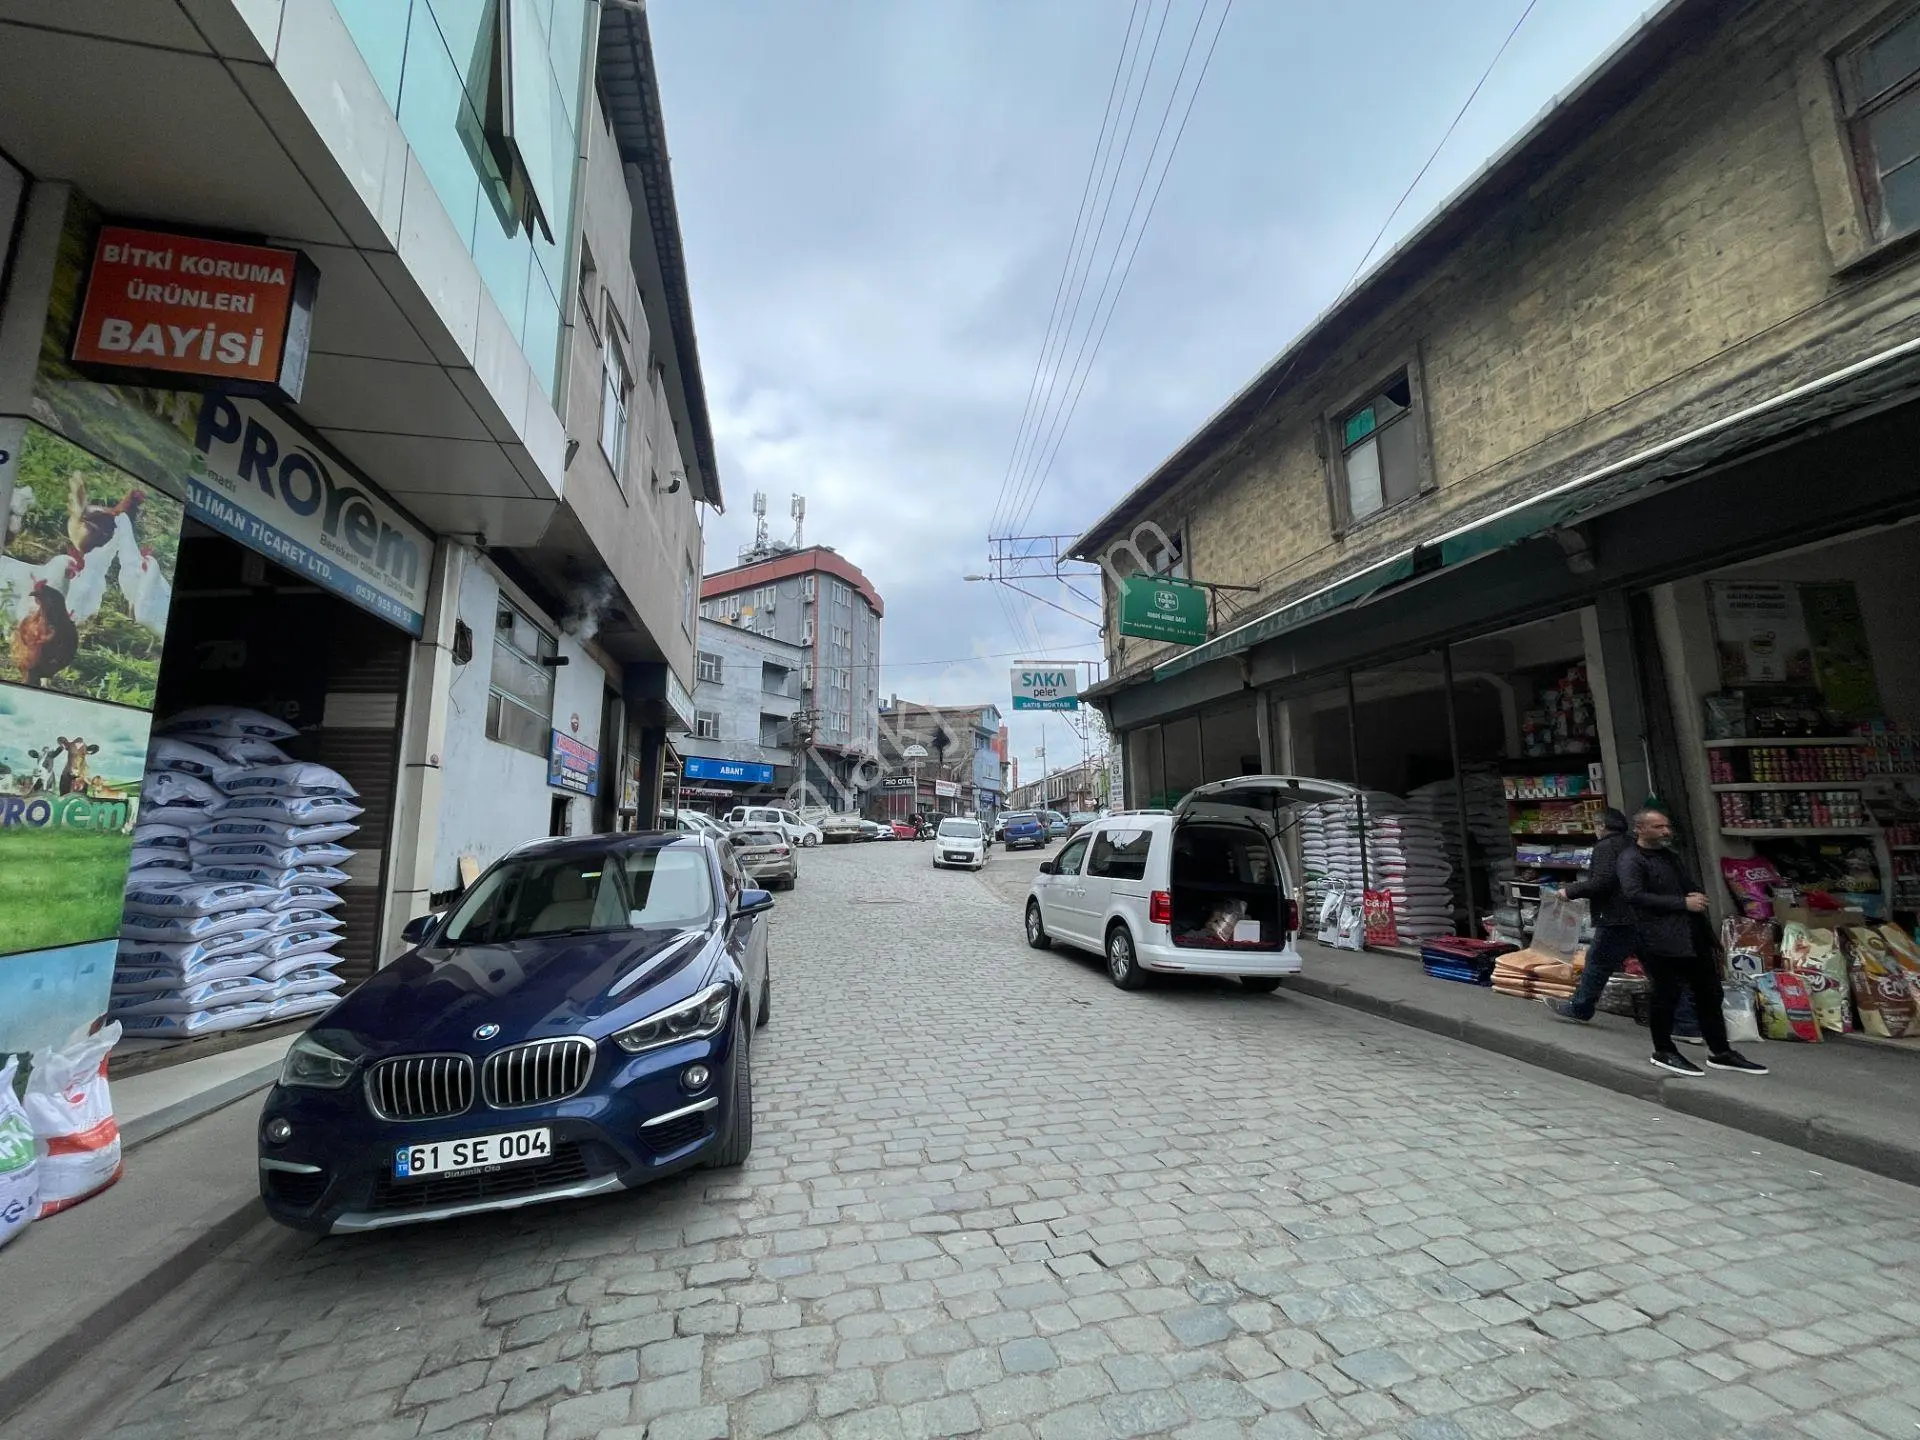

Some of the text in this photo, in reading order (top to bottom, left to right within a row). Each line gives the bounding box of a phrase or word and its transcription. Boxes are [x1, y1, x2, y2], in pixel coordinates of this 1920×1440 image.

[103, 243, 286, 285] BİTKİ KORUMA
[127, 278, 255, 314] ÜRÜNLERİ
[98, 317, 264, 367] BAYİSİ
[250, 519, 306, 565] TİCARET
[308, 554, 333, 580] LTD.
[355, 584, 376, 604] 0537
[1021, 672, 1067, 687] SAKA
[1033, 688, 1057, 698] pelet
[720, 766, 744, 776] ABANT
[398, 1132, 547, 1172] TR 61 SE 004
[443, 1167, 482, 1179] Dinamik
